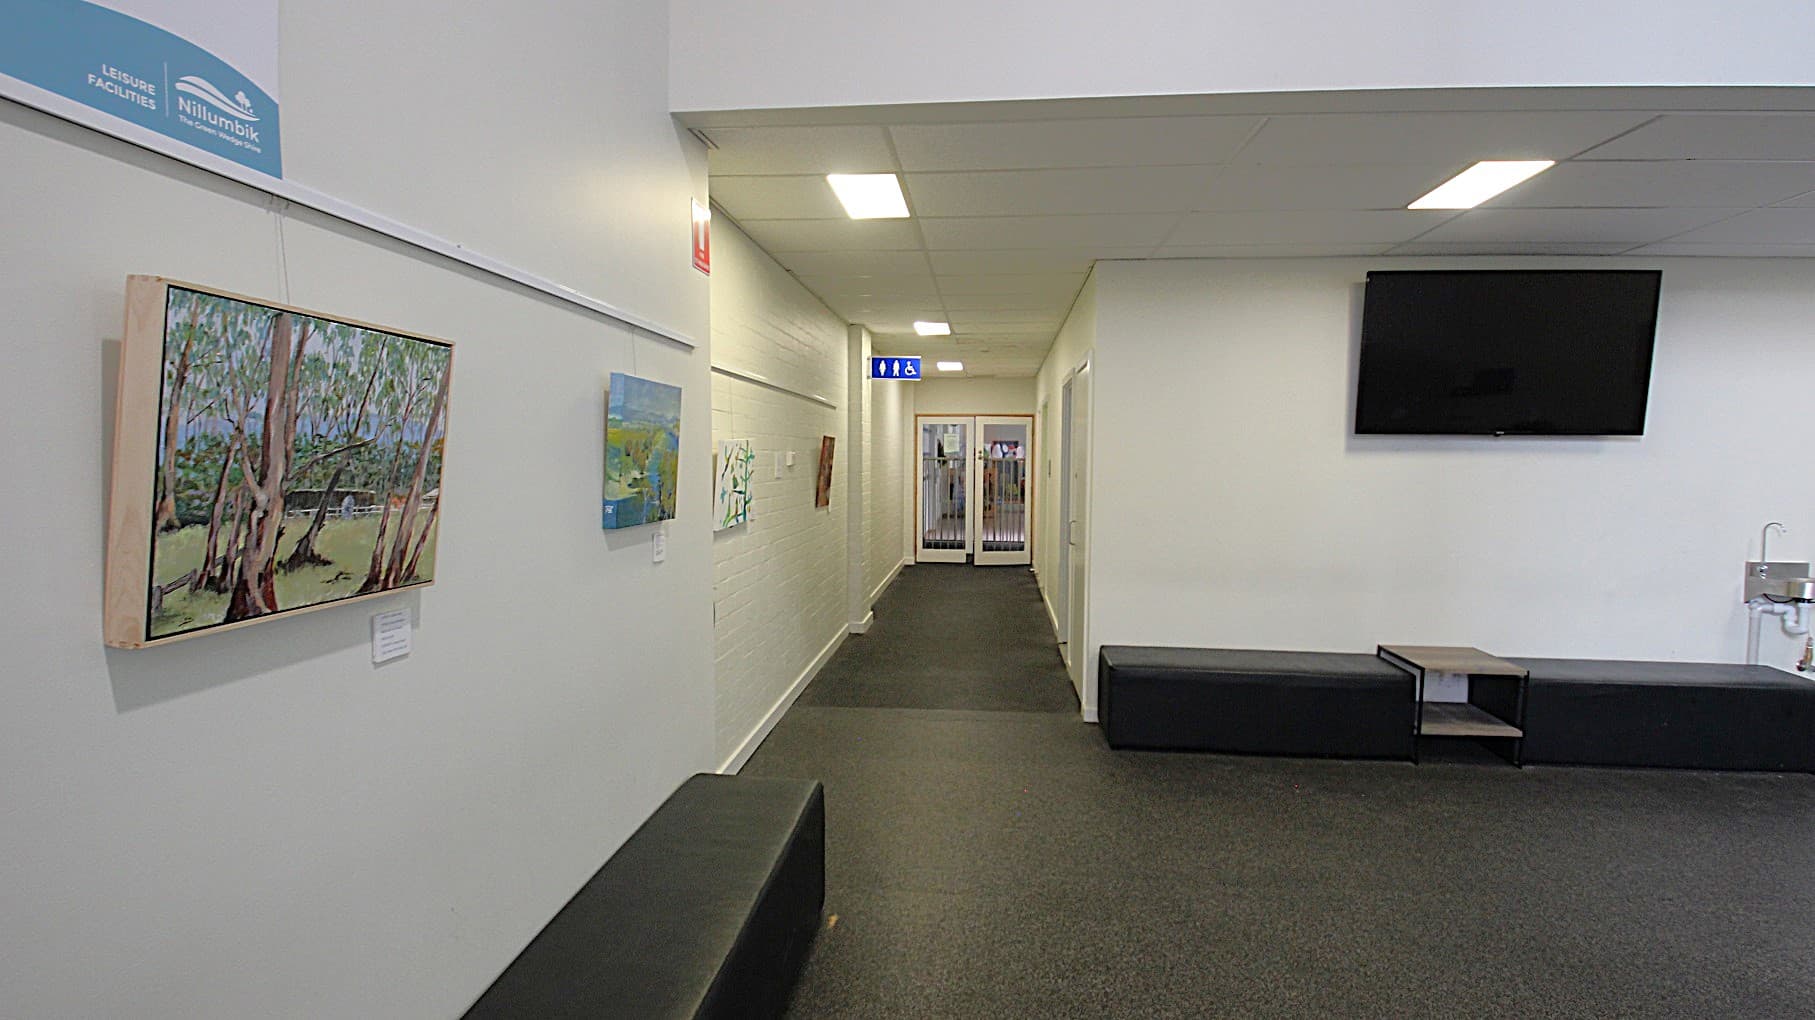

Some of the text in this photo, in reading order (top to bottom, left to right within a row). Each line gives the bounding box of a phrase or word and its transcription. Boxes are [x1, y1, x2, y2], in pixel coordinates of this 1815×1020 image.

[87, 73, 156, 110] FACILITIES
[102, 63, 156, 96] LEISURE
[178, 95, 260, 143] Nillumbik
[178, 114, 194, 127] The
